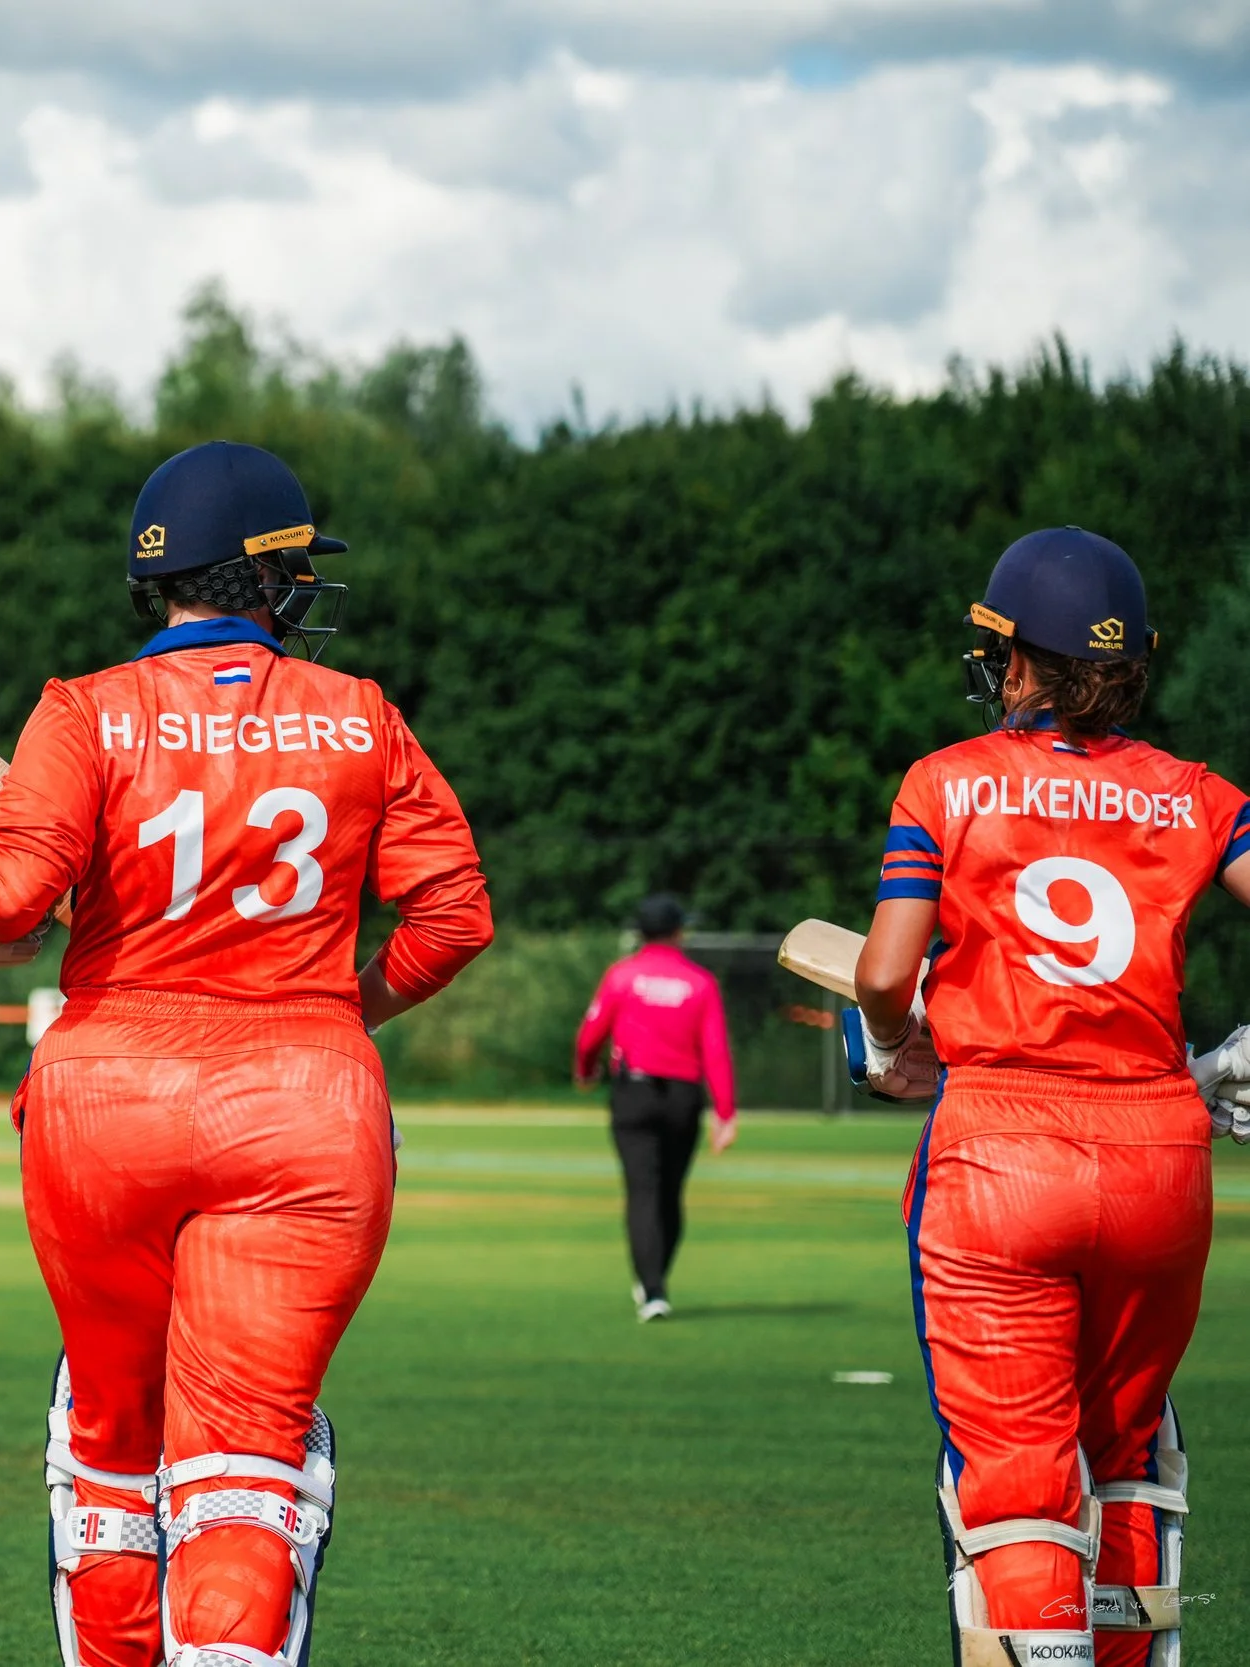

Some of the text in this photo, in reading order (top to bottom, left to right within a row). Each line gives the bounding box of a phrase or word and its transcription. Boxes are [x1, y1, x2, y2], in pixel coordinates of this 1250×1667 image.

[137, 550, 164, 559] MASURI
[270, 530, 304, 543] MASURI
[1089, 640, 1123, 650] MASURI
[101, 712, 374, 755] H. SIEGERS
[944, 775, 1197, 829] MOLKENBOER
[138, 787, 328, 923] 13
[1015, 856, 1136, 987] 9
